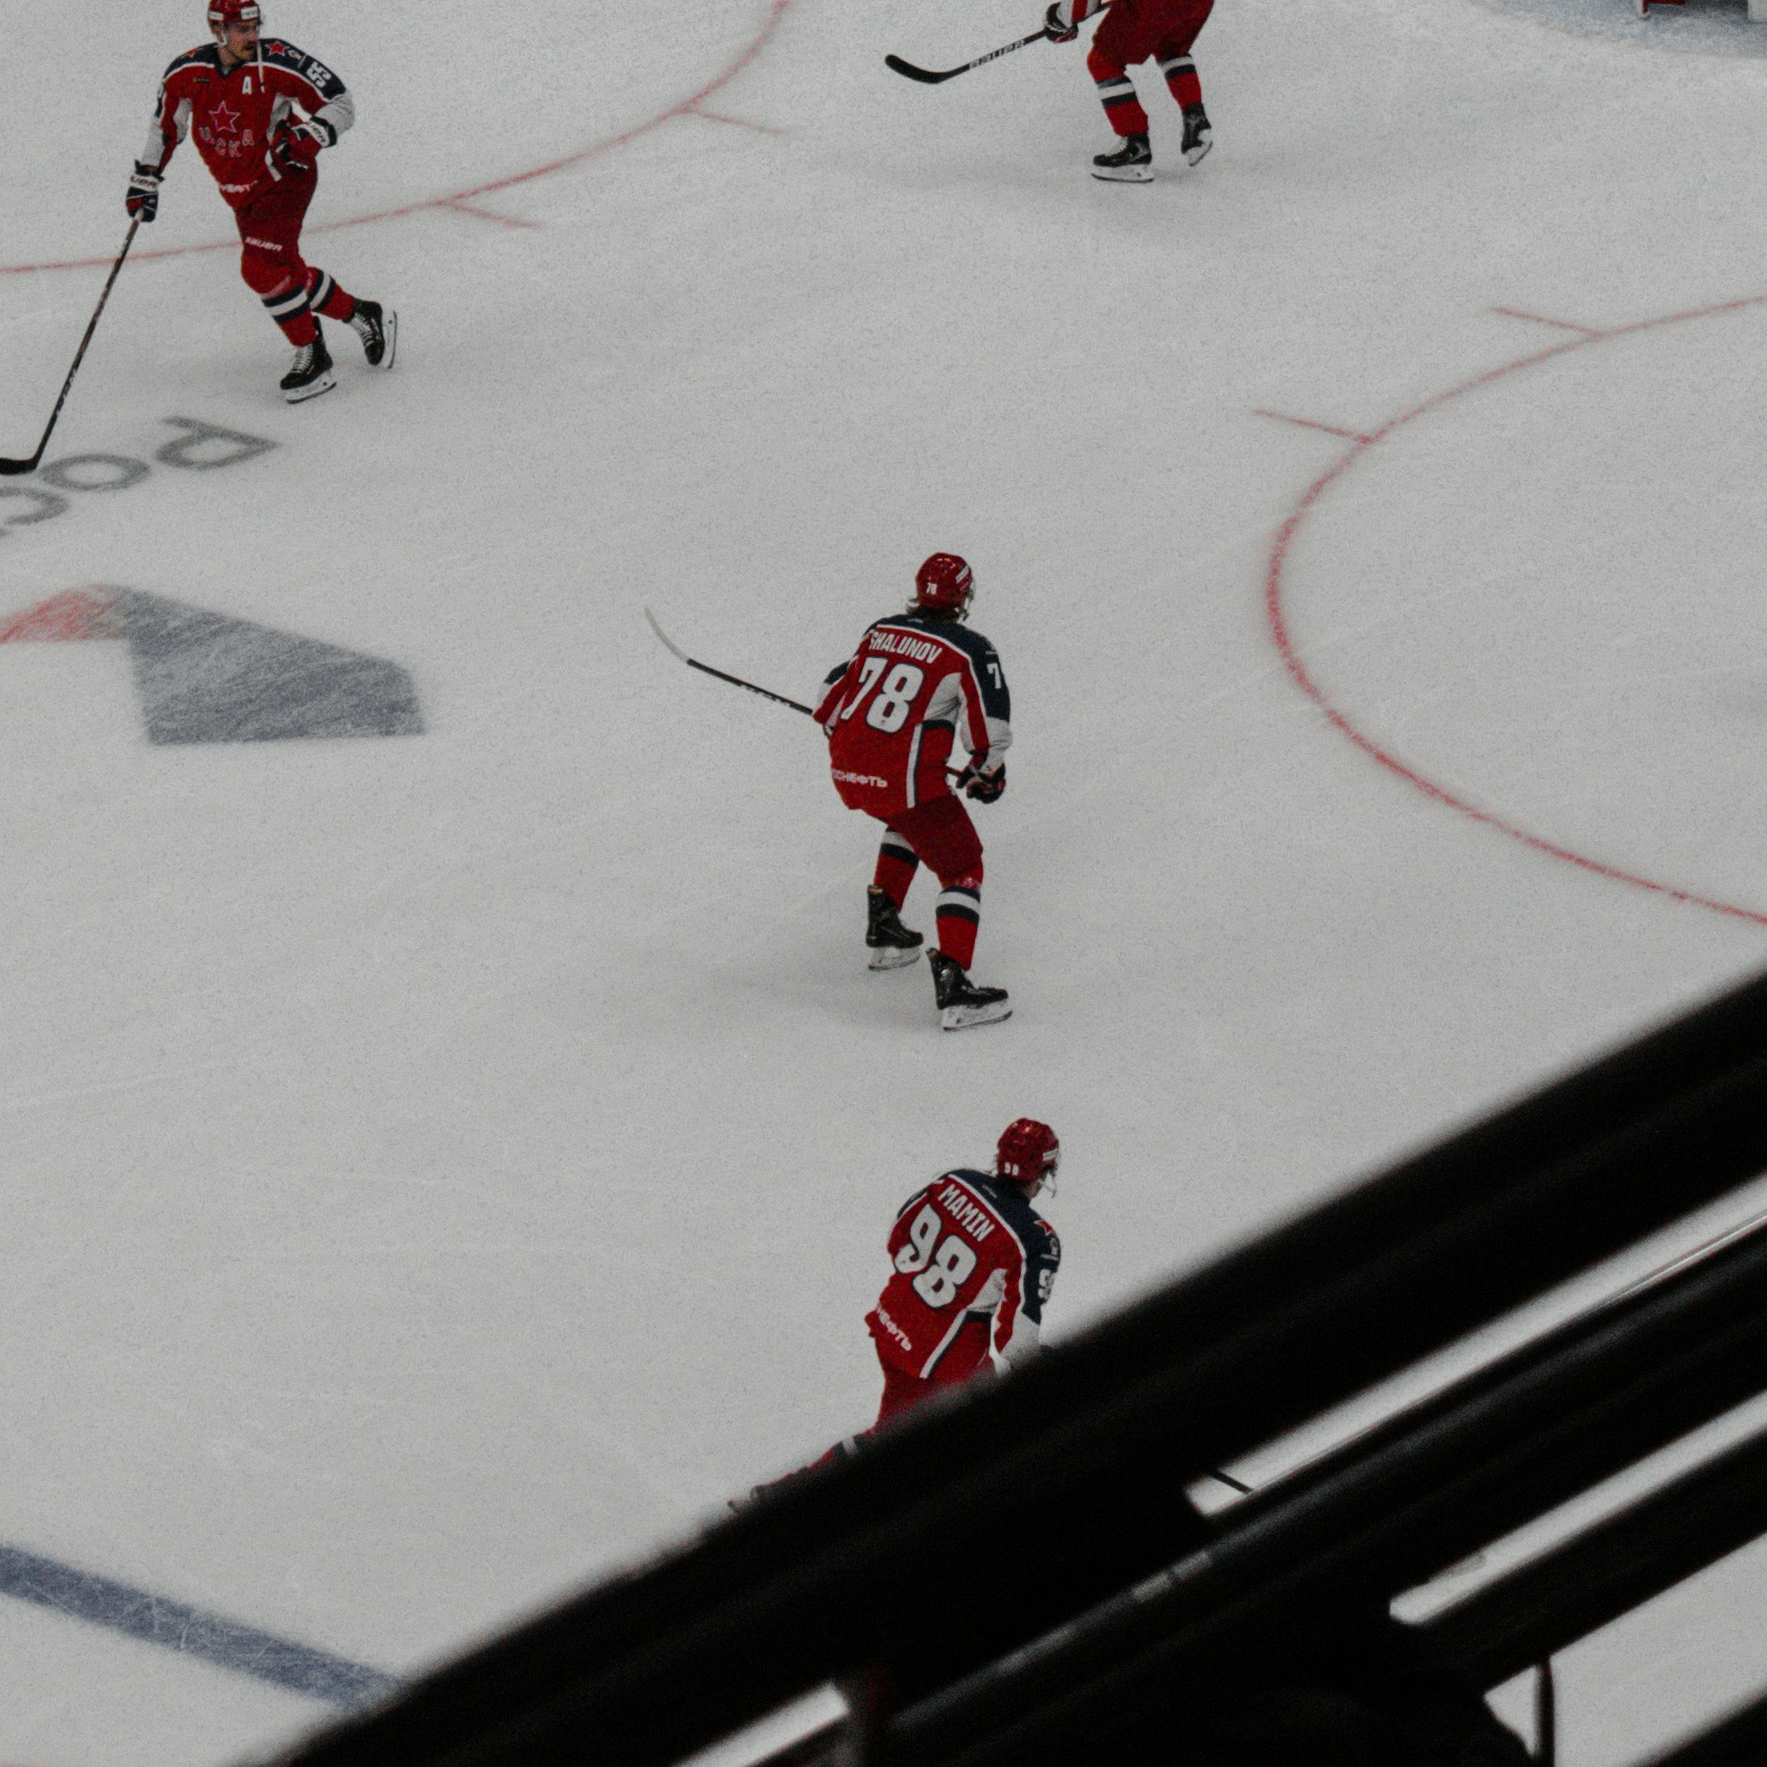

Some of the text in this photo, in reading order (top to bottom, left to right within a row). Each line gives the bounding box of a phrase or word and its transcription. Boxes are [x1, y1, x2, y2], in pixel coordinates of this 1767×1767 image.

[241, 74, 253, 96] A
[305, 59, 333, 89] 55
[868, 630, 943, 665] SHALUNOV
[839, 655, 926, 735] 78
[936, 1182, 996, 1243] MAMIN
[893, 1201, 979, 1311] 98
